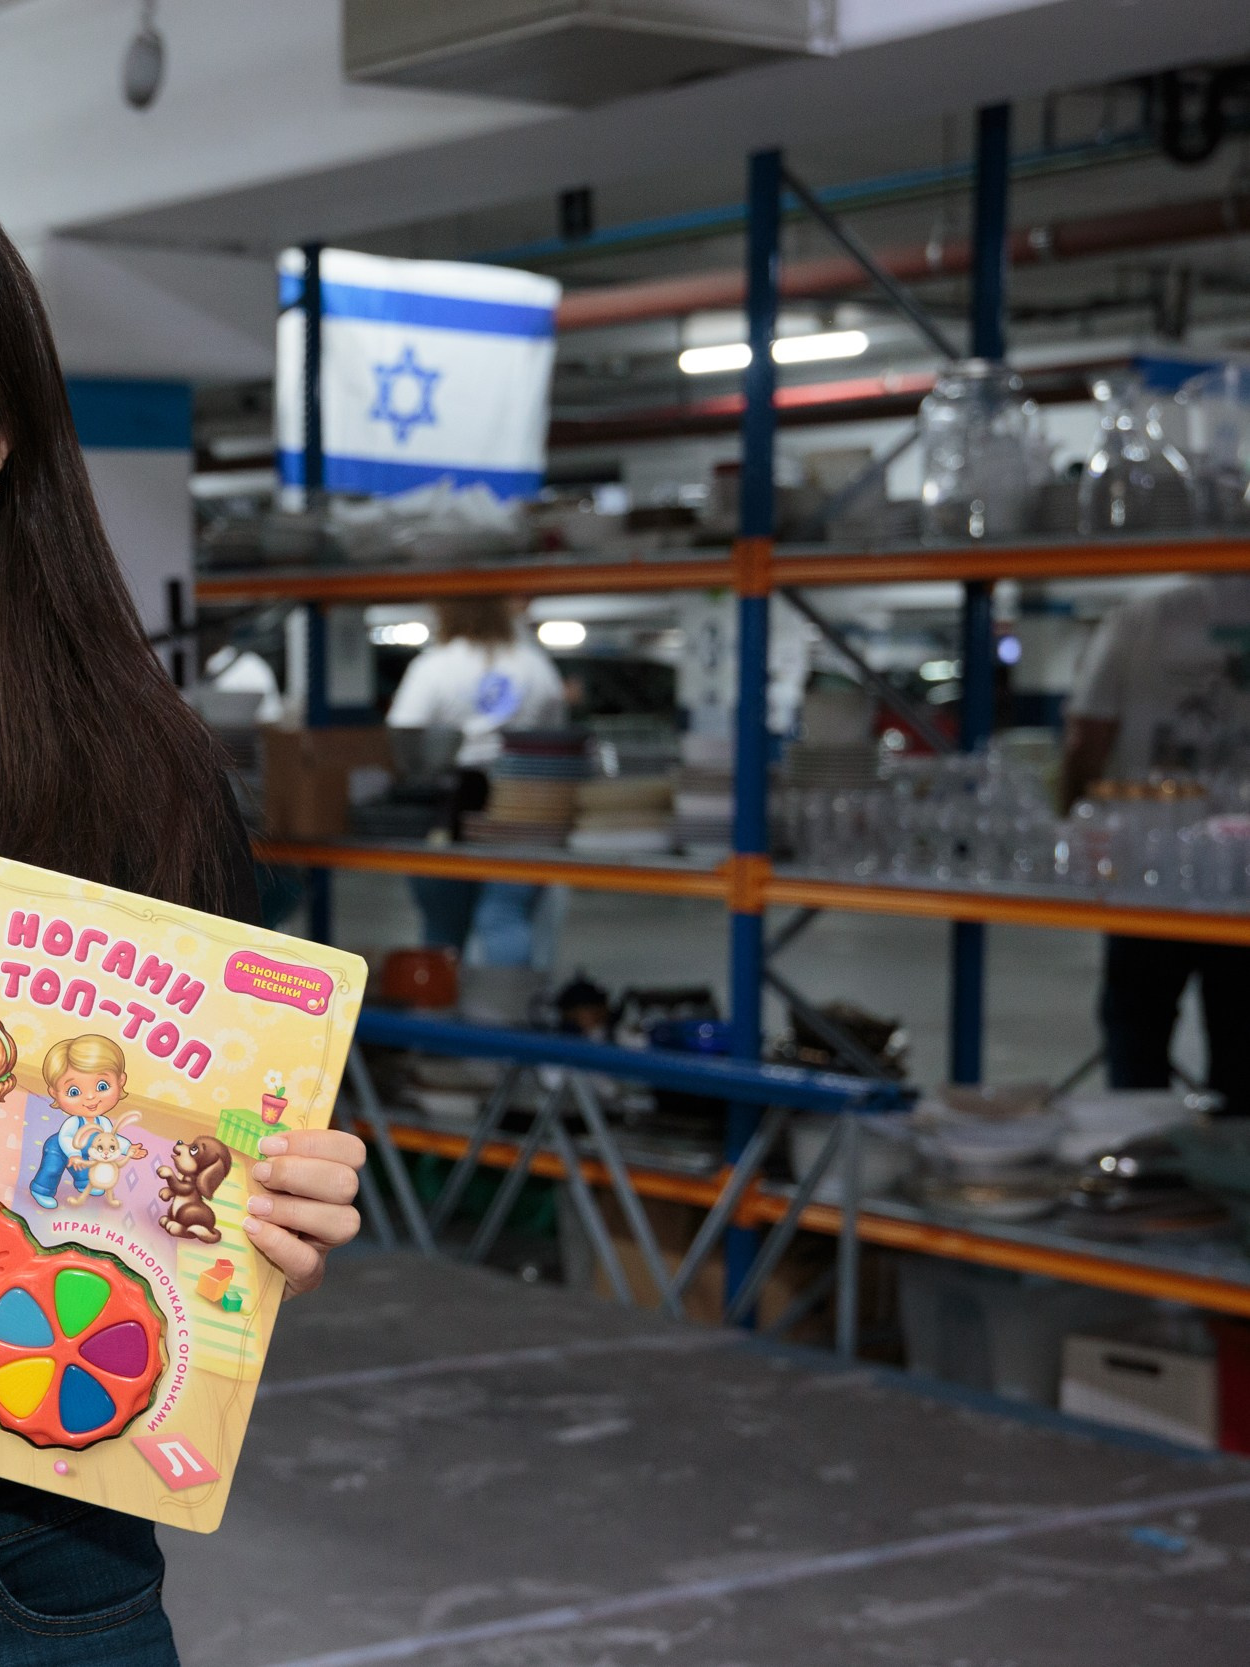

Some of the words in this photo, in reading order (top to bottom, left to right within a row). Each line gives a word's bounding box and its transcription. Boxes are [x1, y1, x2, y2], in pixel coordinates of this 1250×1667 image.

[7, 910, 205, 1016] НОГАМИ
[235, 961, 322, 992] РАЗНОЦВЕТНЫЕ
[253, 978, 302, 998] ПЕСЕНКИ
[52, 1220, 101, 1236] ИГРАЙ
[105, 1231, 125, 1246] НА
[127, 1242, 187, 1325] КНОПОЧКАХ
[147, 1342, 189, 1432] ОГОНЬКАМИ
